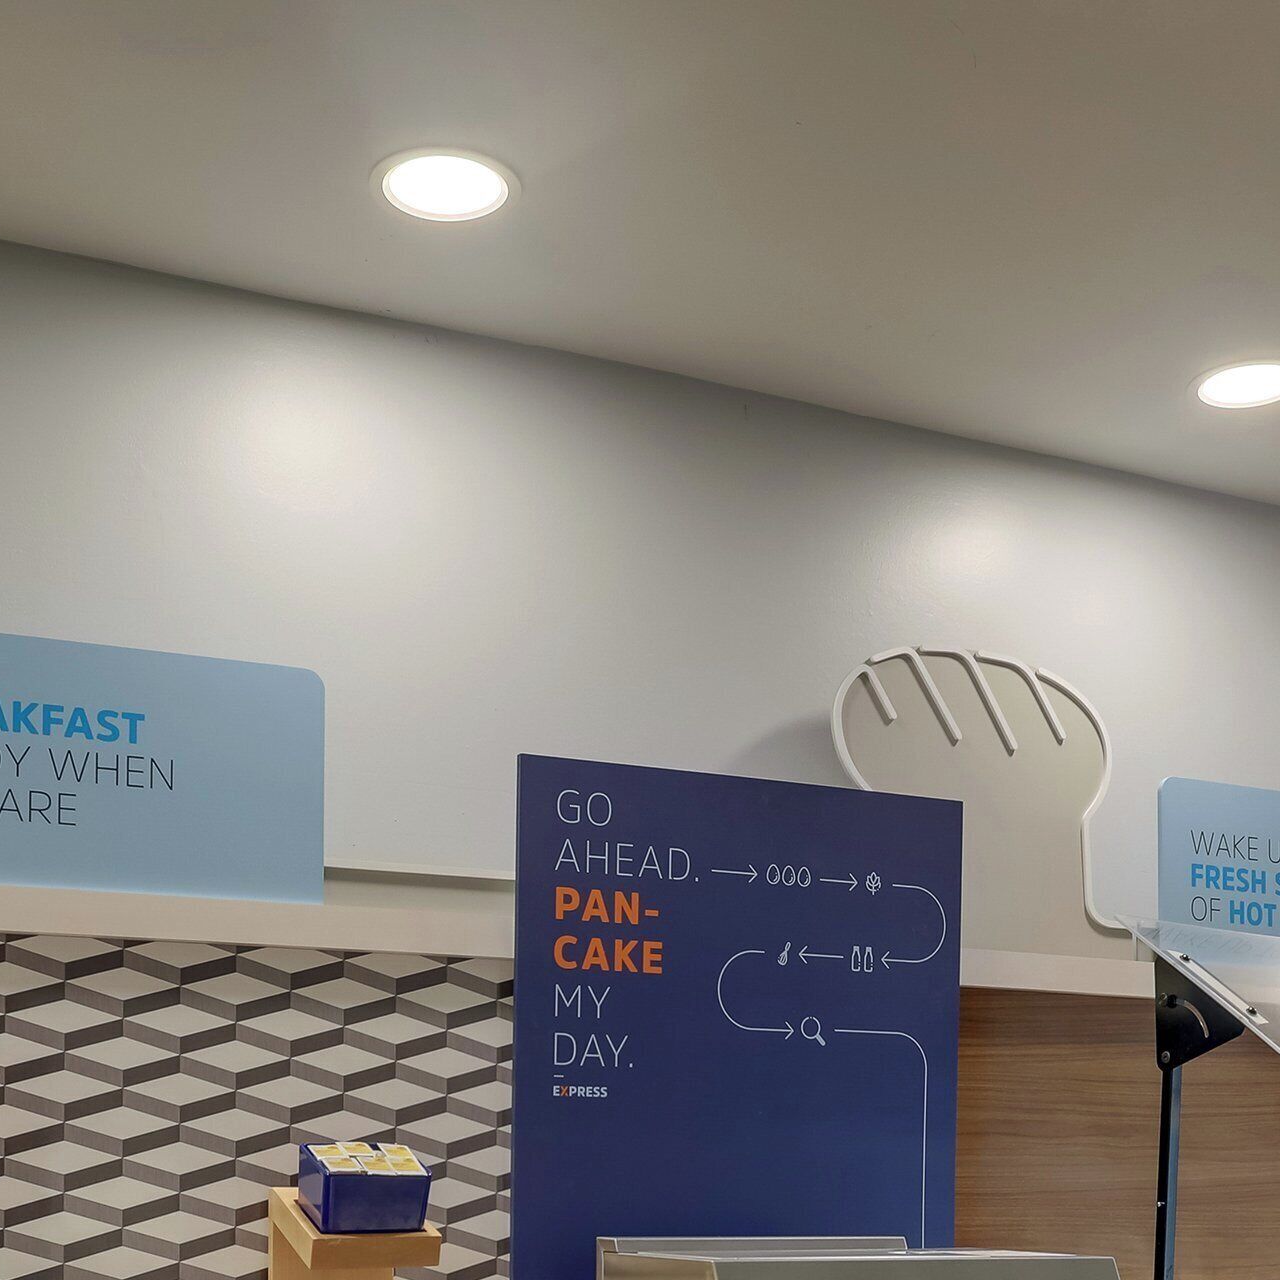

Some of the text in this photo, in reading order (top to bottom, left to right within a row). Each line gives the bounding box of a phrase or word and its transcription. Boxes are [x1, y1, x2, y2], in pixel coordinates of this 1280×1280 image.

[47, 747, 175, 792] WHEN
[555, 788, 613, 827] GO
[554, 837, 701, 883] AHEAD.
[1189, 828, 1259, 862] WAKE
[1190, 862, 1268, 895] FRESH
[554, 886, 660, 926] PAN-
[1190, 895, 1222, 923] OF
[1228, 899, 1279, 929] HOT
[552, 934, 664, 975] CAKE
[553, 983, 612, 1019] MY
[552, 1032, 635, 1069] DAY.
[552, 1084, 608, 1099] EXPRESS
